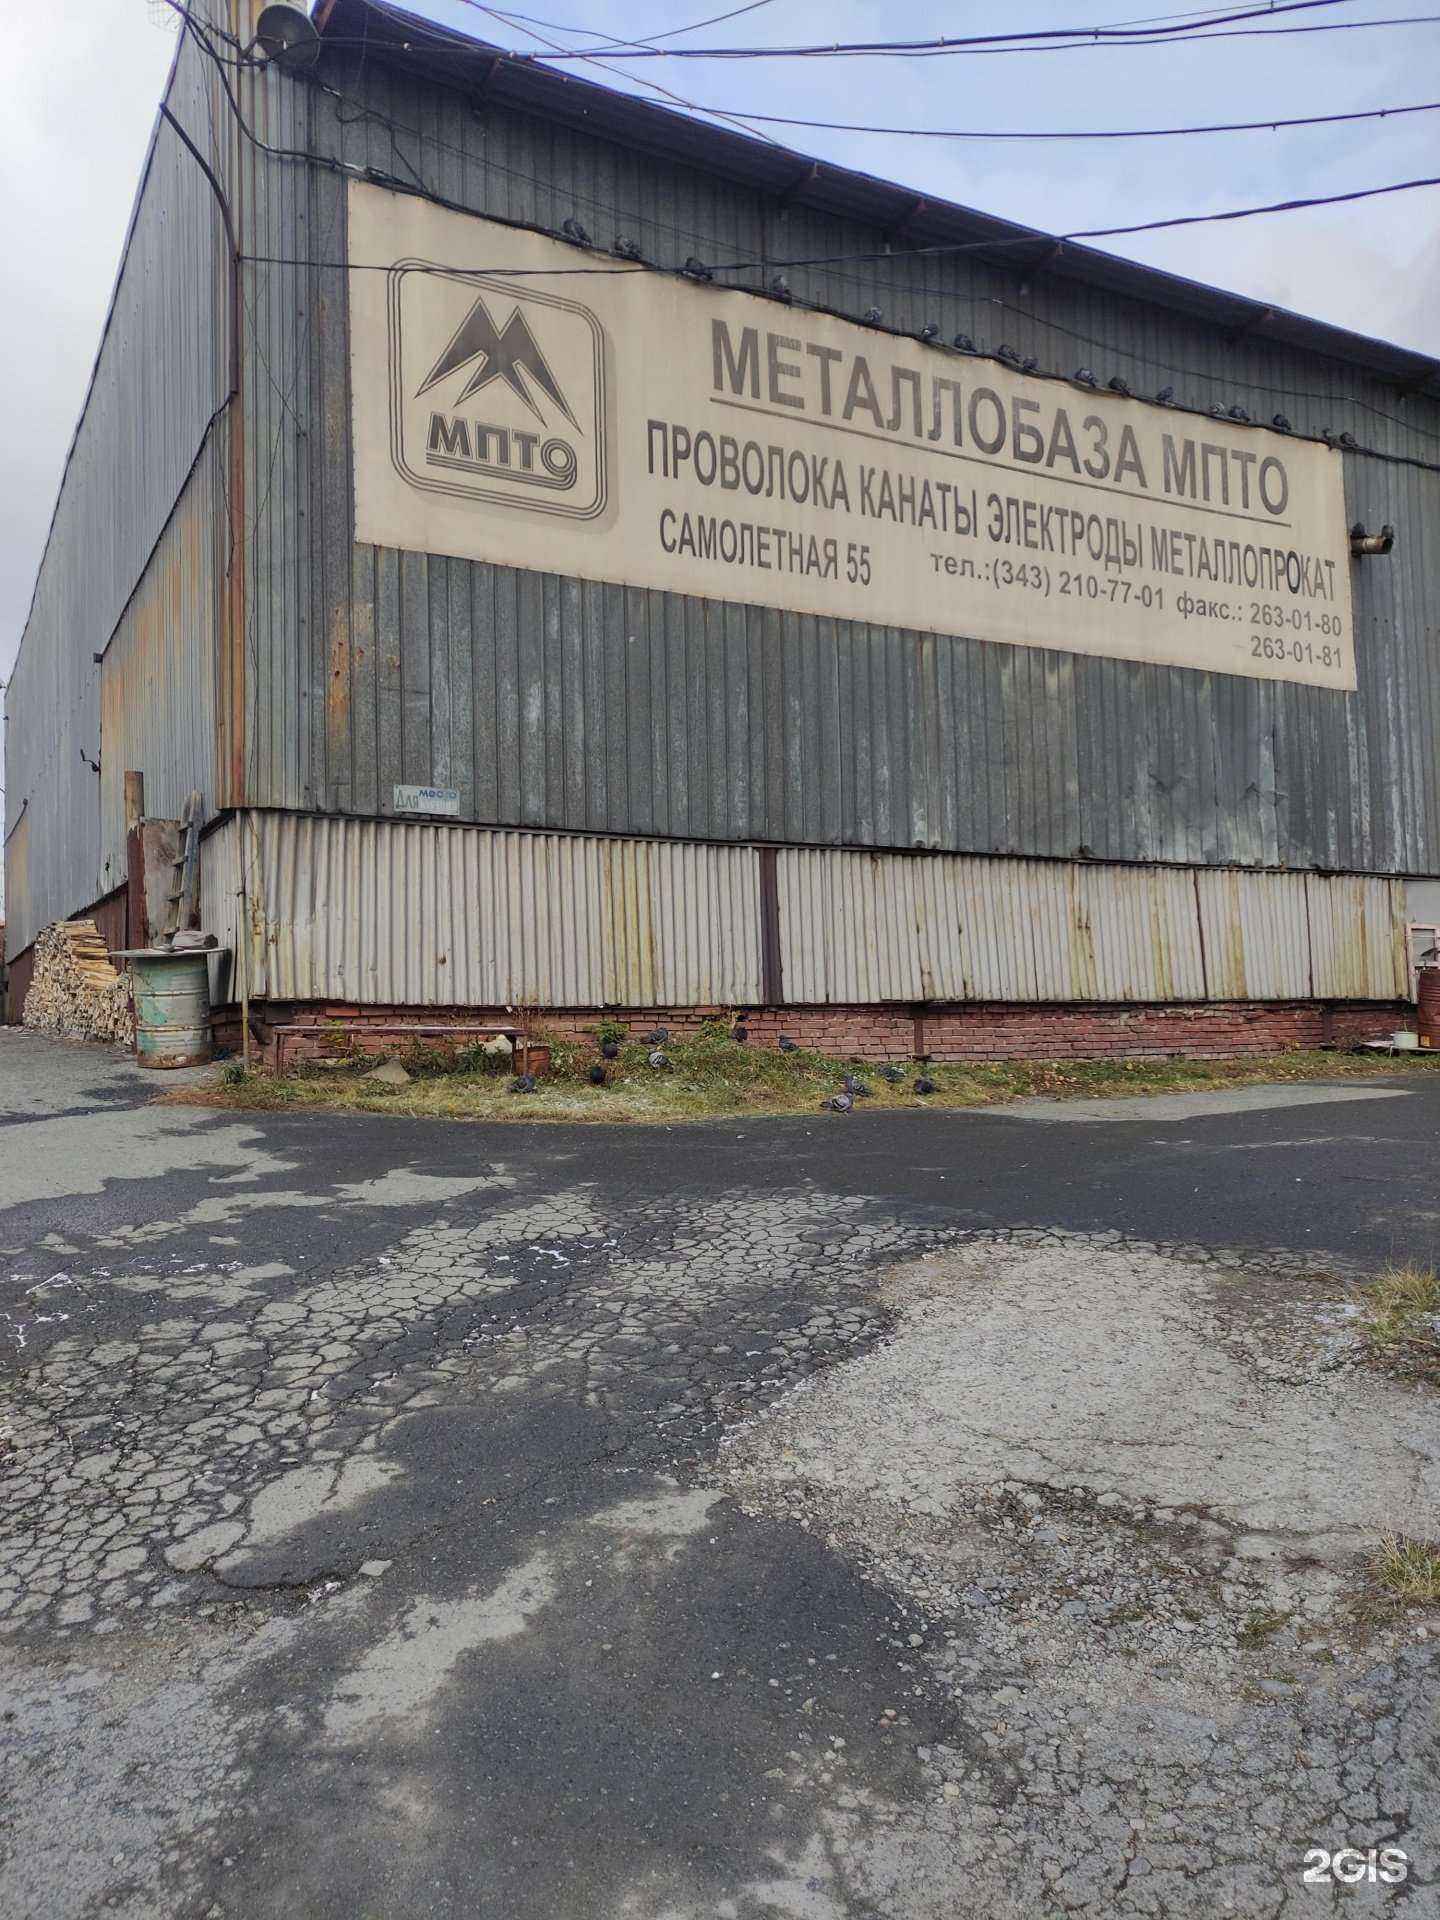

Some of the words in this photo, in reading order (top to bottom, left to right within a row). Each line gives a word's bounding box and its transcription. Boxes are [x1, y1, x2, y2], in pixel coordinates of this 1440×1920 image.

[427, 412, 577, 480] МПТО
[711, 318, 1148, 488] МЕТАЛЛОБАЗА
[1161, 432, 1289, 516] МПТО
[647, 419, 850, 512] ПРОВОЛОКА
[859, 464, 977, 538] КАНАТЫ
[987, 493, 1143, 570] ЭЛЕКТРОДЫ
[1150, 525, 1336, 601] МЕТАЛЛОПРОКАТ
[660, 509, 838, 580] САМОЛЕТНАЯ
[847, 542, 871, 586] 55
[1059, 571, 1164, 610] 210-77-01
[1176, 591, 1242, 623] факс.:
[1250, 602, 1342, 637] 263-01-80
[1251, 635, 1342, 669] 263-01-81
